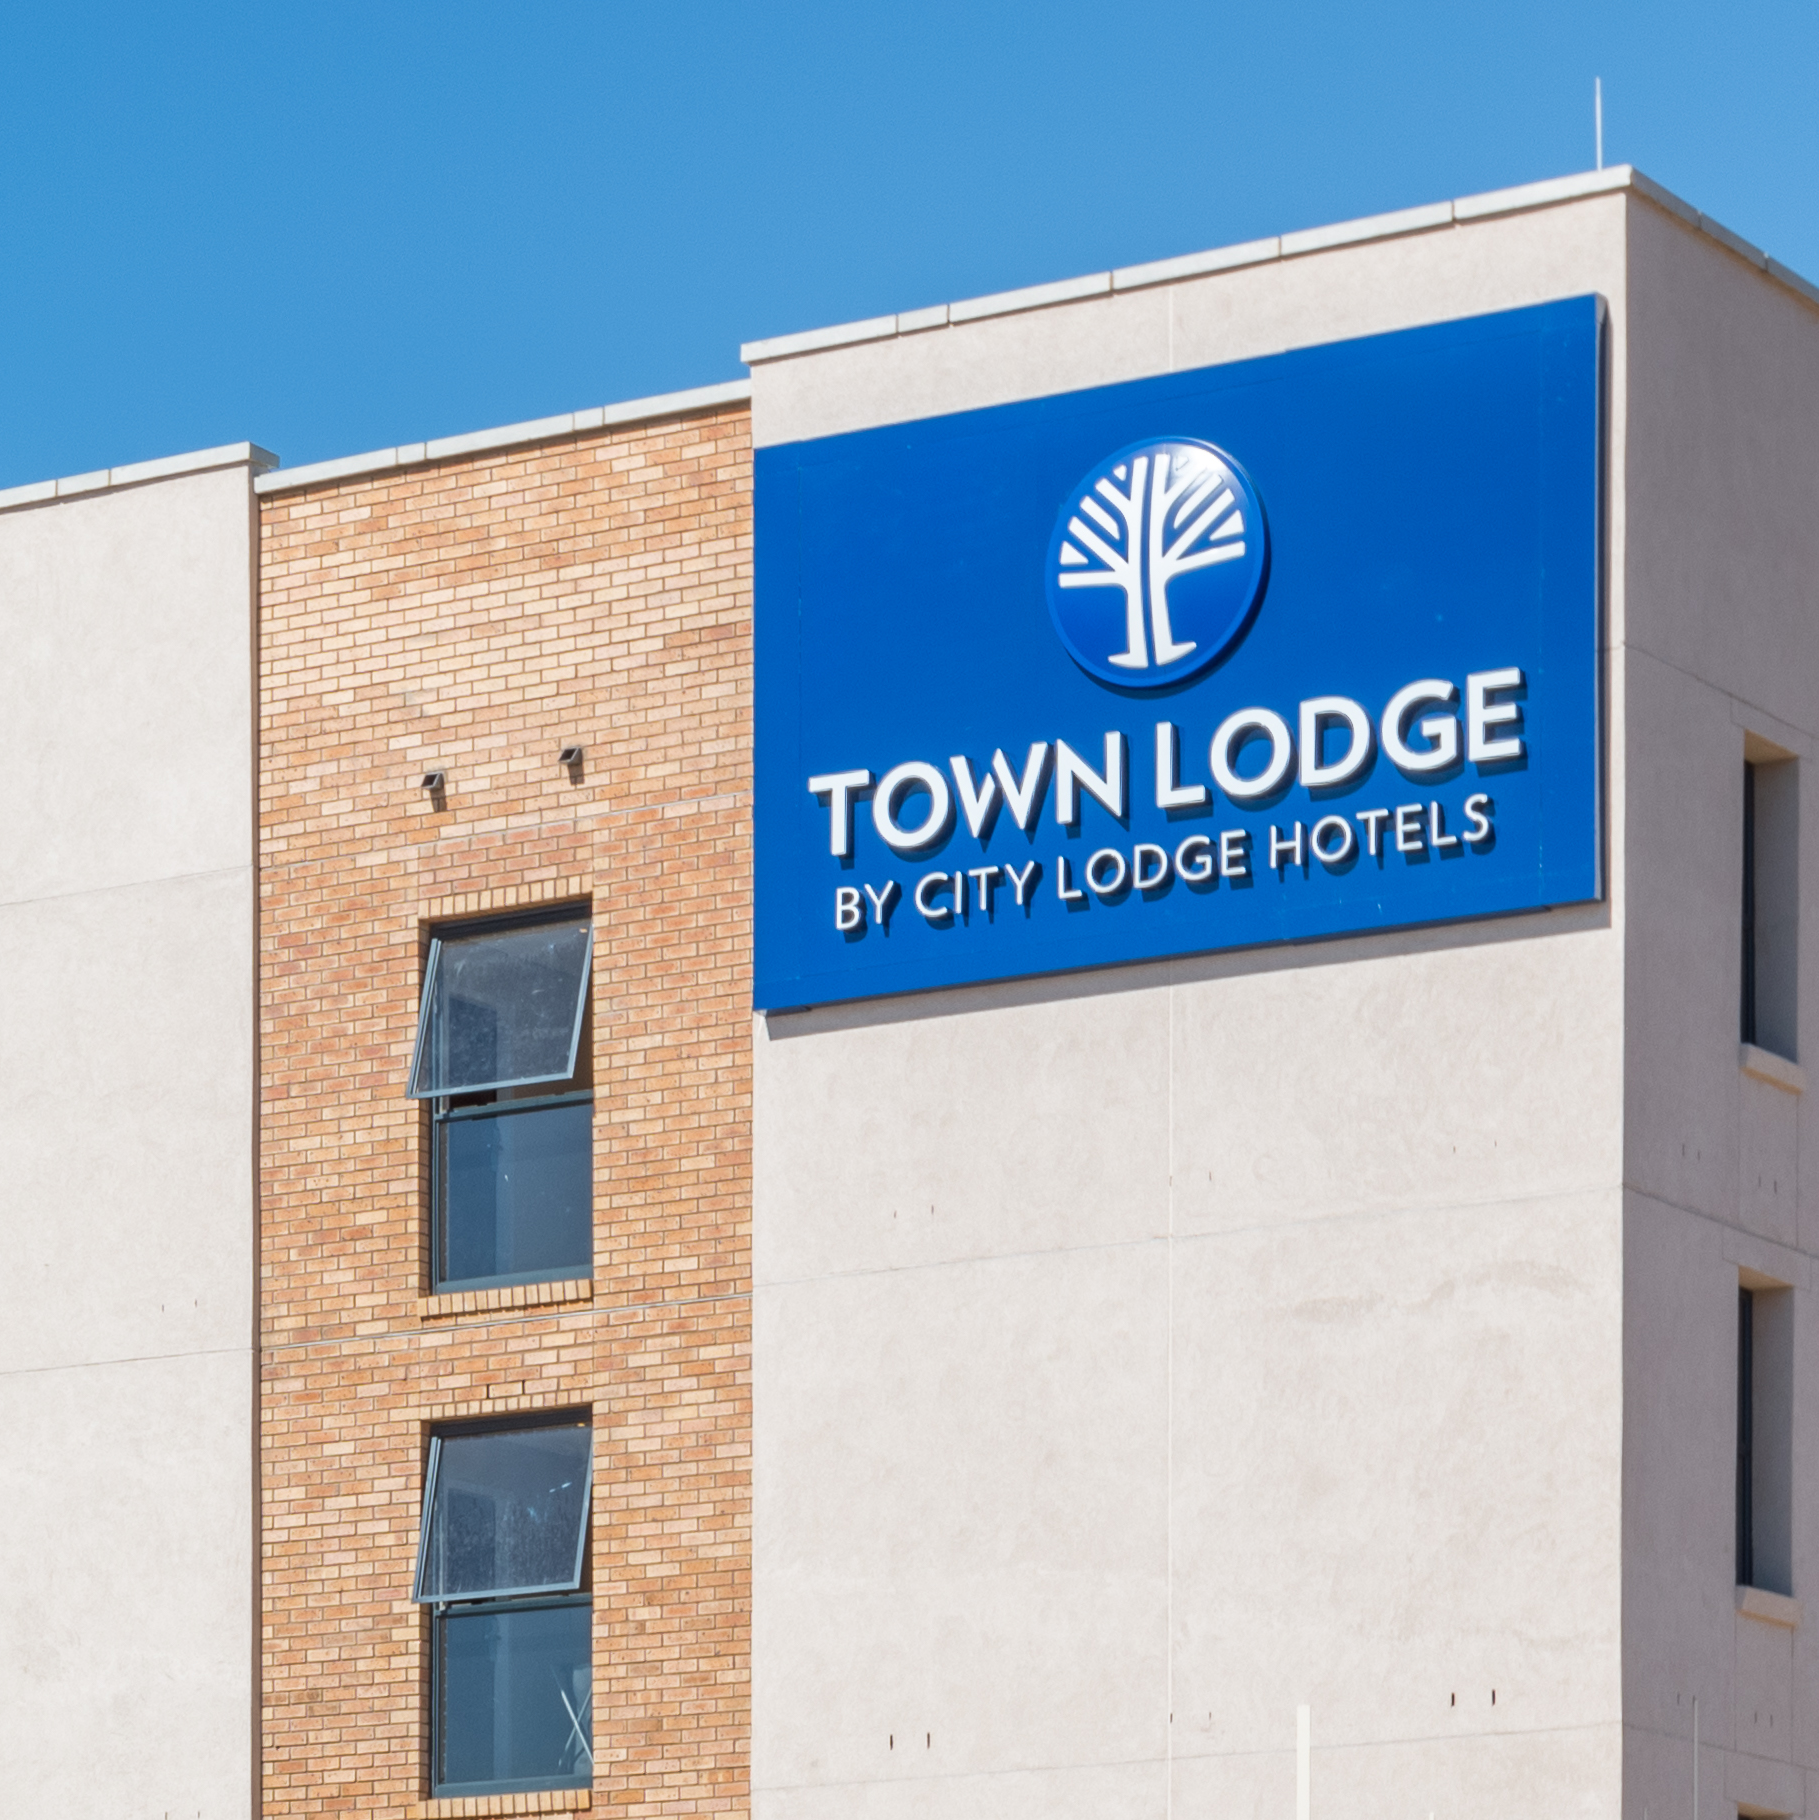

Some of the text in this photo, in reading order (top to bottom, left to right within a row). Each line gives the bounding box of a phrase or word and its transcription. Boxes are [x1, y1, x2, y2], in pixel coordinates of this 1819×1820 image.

[808, 666, 1523, 857] TOWN LODGE
[835, 794, 1491, 932] BY CITY LODGE HOTELS
